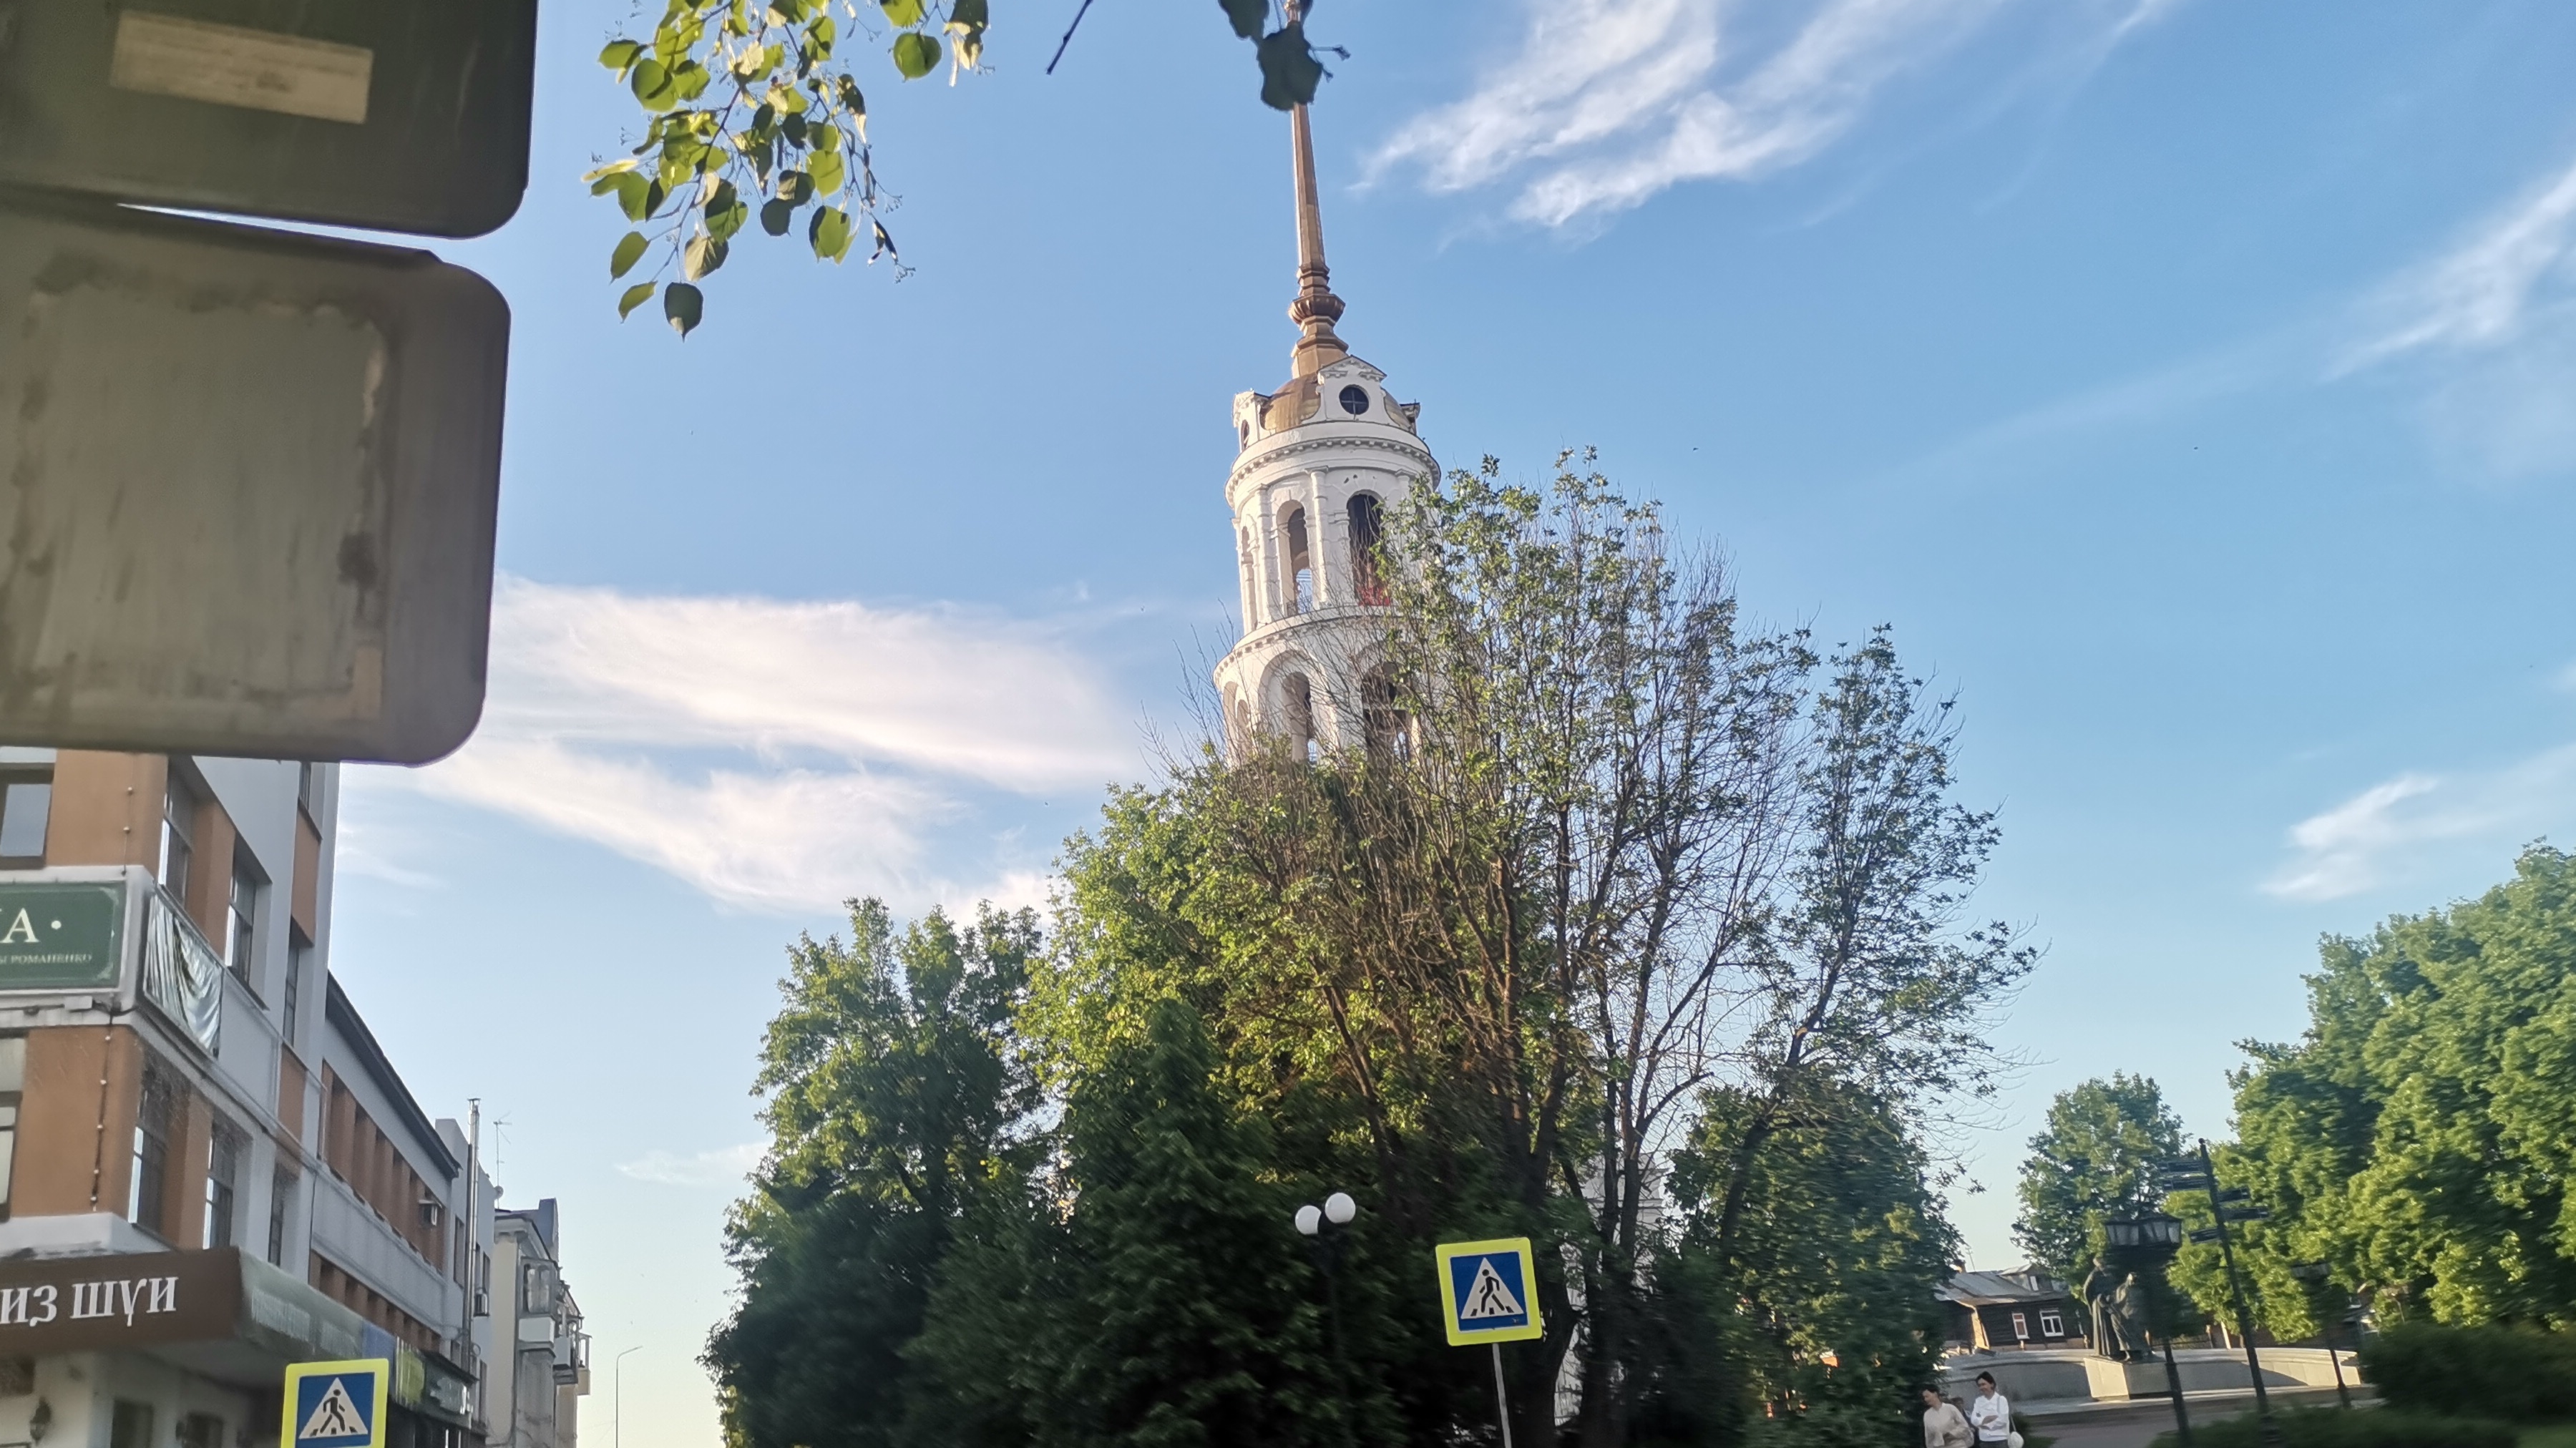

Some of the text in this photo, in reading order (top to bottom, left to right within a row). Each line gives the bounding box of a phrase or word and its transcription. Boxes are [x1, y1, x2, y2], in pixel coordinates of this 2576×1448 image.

[0, 907, 40, 943] А
[0, 1276, 179, 1327] ИЗ ШУИ
